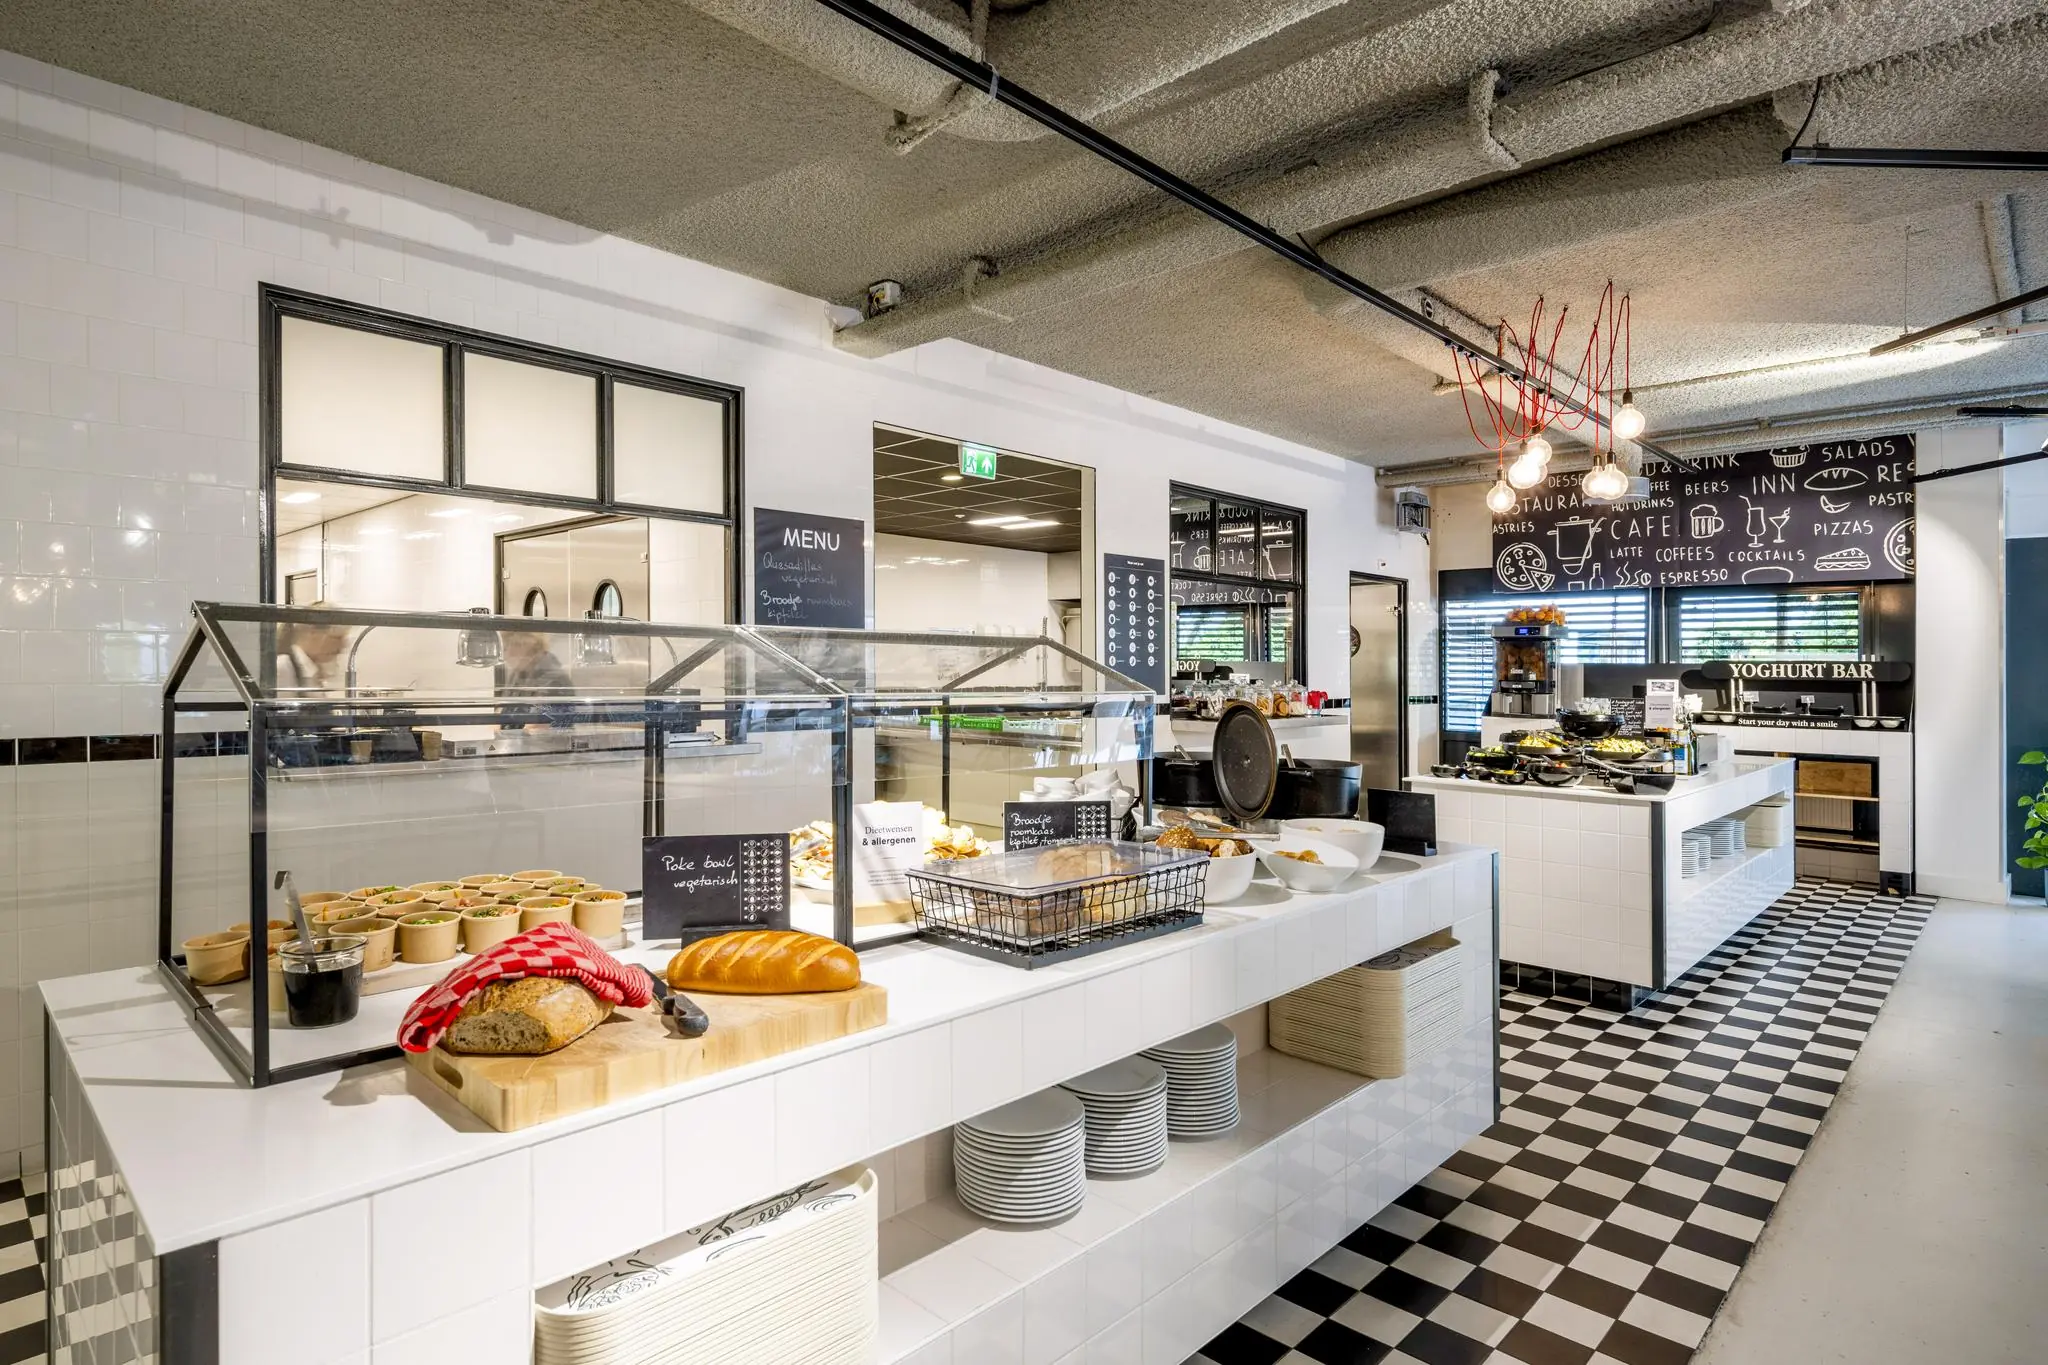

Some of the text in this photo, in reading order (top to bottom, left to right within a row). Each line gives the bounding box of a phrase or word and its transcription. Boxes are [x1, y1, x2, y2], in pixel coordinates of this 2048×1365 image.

[1822, 440, 1895, 462] SALADS
[1548, 473, 1583, 489] DESSE
[1650, 480, 1671, 492] FFEE
[1685, 480, 1730, 496] BEERS
[1752, 472, 1795, 495] INN
[1633, 496, 1675, 511] DRINKS
[1492, 521, 1535, 535] ASTRIES
[1610, 515, 1671, 540] CAFE
[1814, 519, 1874, 536] PIZZAS
[783, 527, 840, 551] MENU
[1610, 546, 1643, 559] LATTE
[1655, 546, 1715, 562] COFFEES
[1728, 549, 1806, 563] COCKTAILS
[1660, 568, 1729, 585] ESPRESSO
[760, 590, 803, 611] Broodje
[1729, 662, 1875, 679] YOGHURT BAR
[1738, 718, 1756, 726] Start
[1776, 719, 1790, 728] day
[1791, 719, 1809, 727] with
[1816, 720, 1838, 728] smile
[1011, 812, 1053, 830] Broodje
[865, 825, 913, 835] Dieetwensen
[1010, 827, 1054, 837] roomkaas
[862, 836, 916, 847] & allergenen
[661, 854, 735, 871] Poke bowl
[674, 870, 738, 894] vegetarisch
